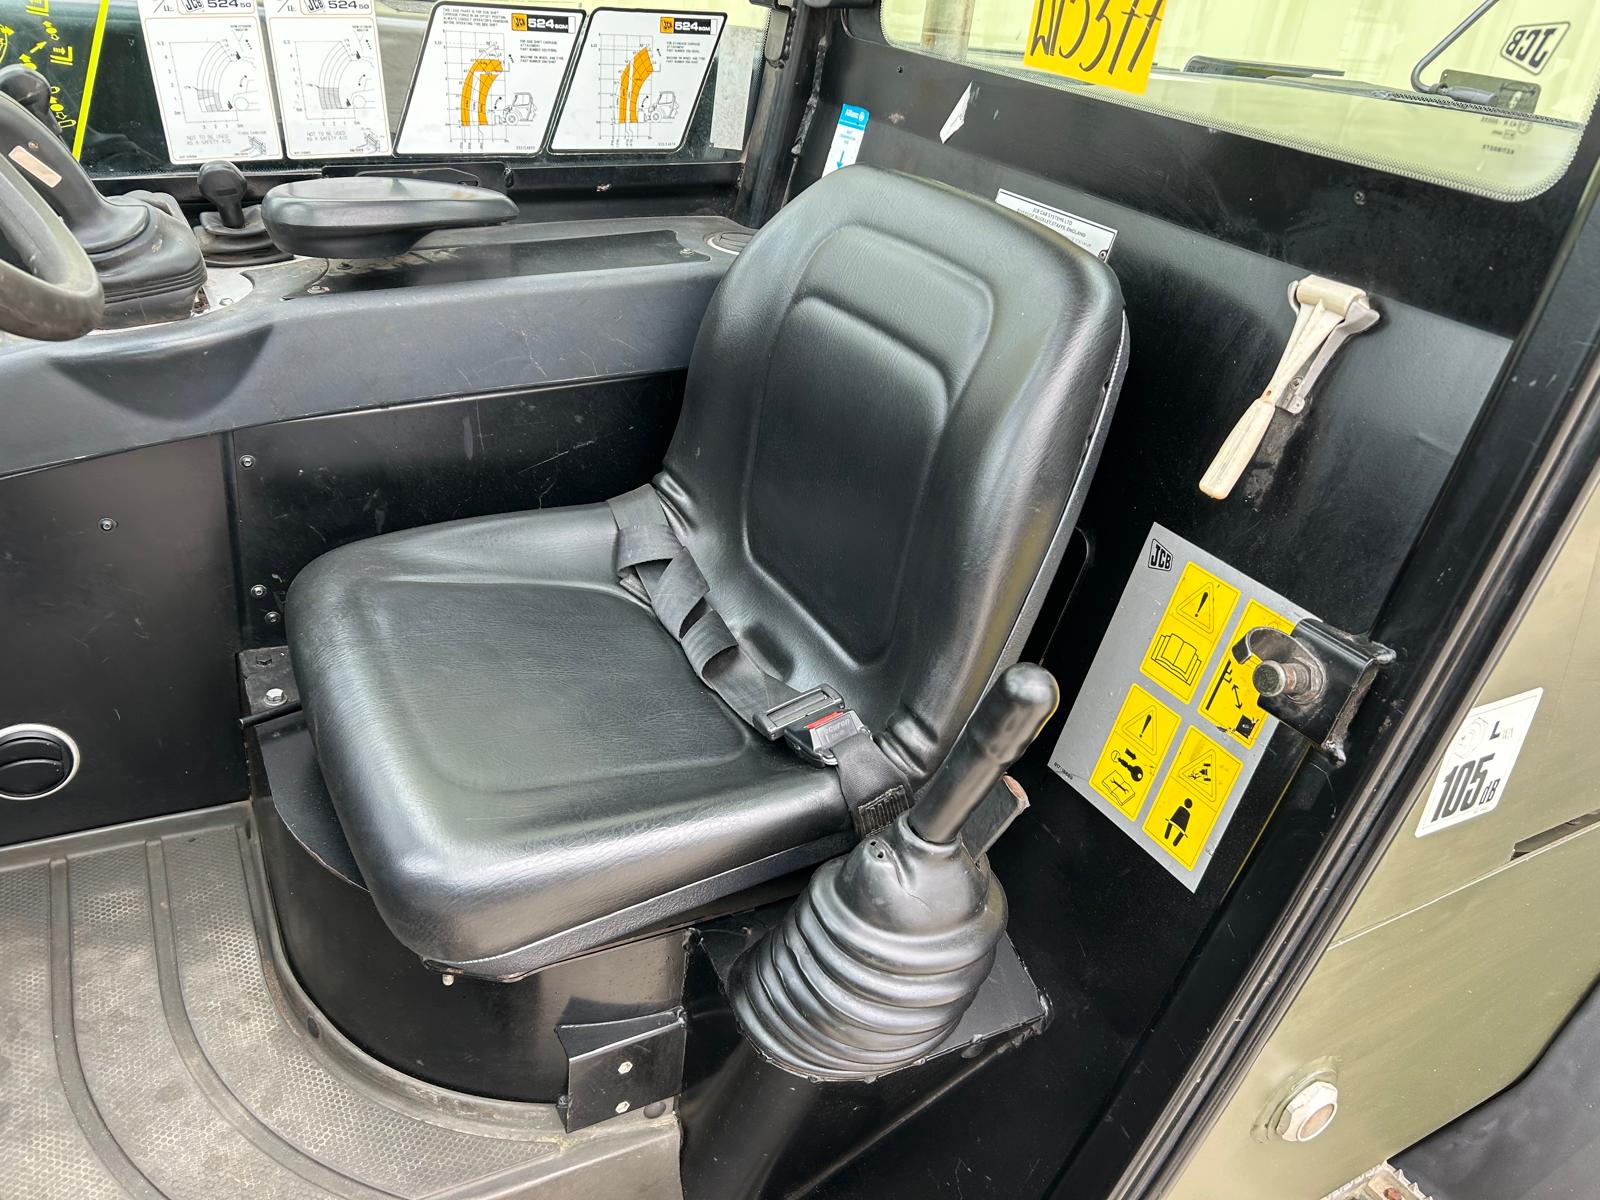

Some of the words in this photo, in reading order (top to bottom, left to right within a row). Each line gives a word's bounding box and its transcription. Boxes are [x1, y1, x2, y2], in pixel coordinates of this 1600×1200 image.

[328, 1, 357, 9] 524
[527, 18, 555, 29] 524
[674, 21, 698, 31] 524
[1150, 543, 1172, 570] JCB
[1431, 753, 1496, 823] 105
[1478, 778, 1501, 805] dB
